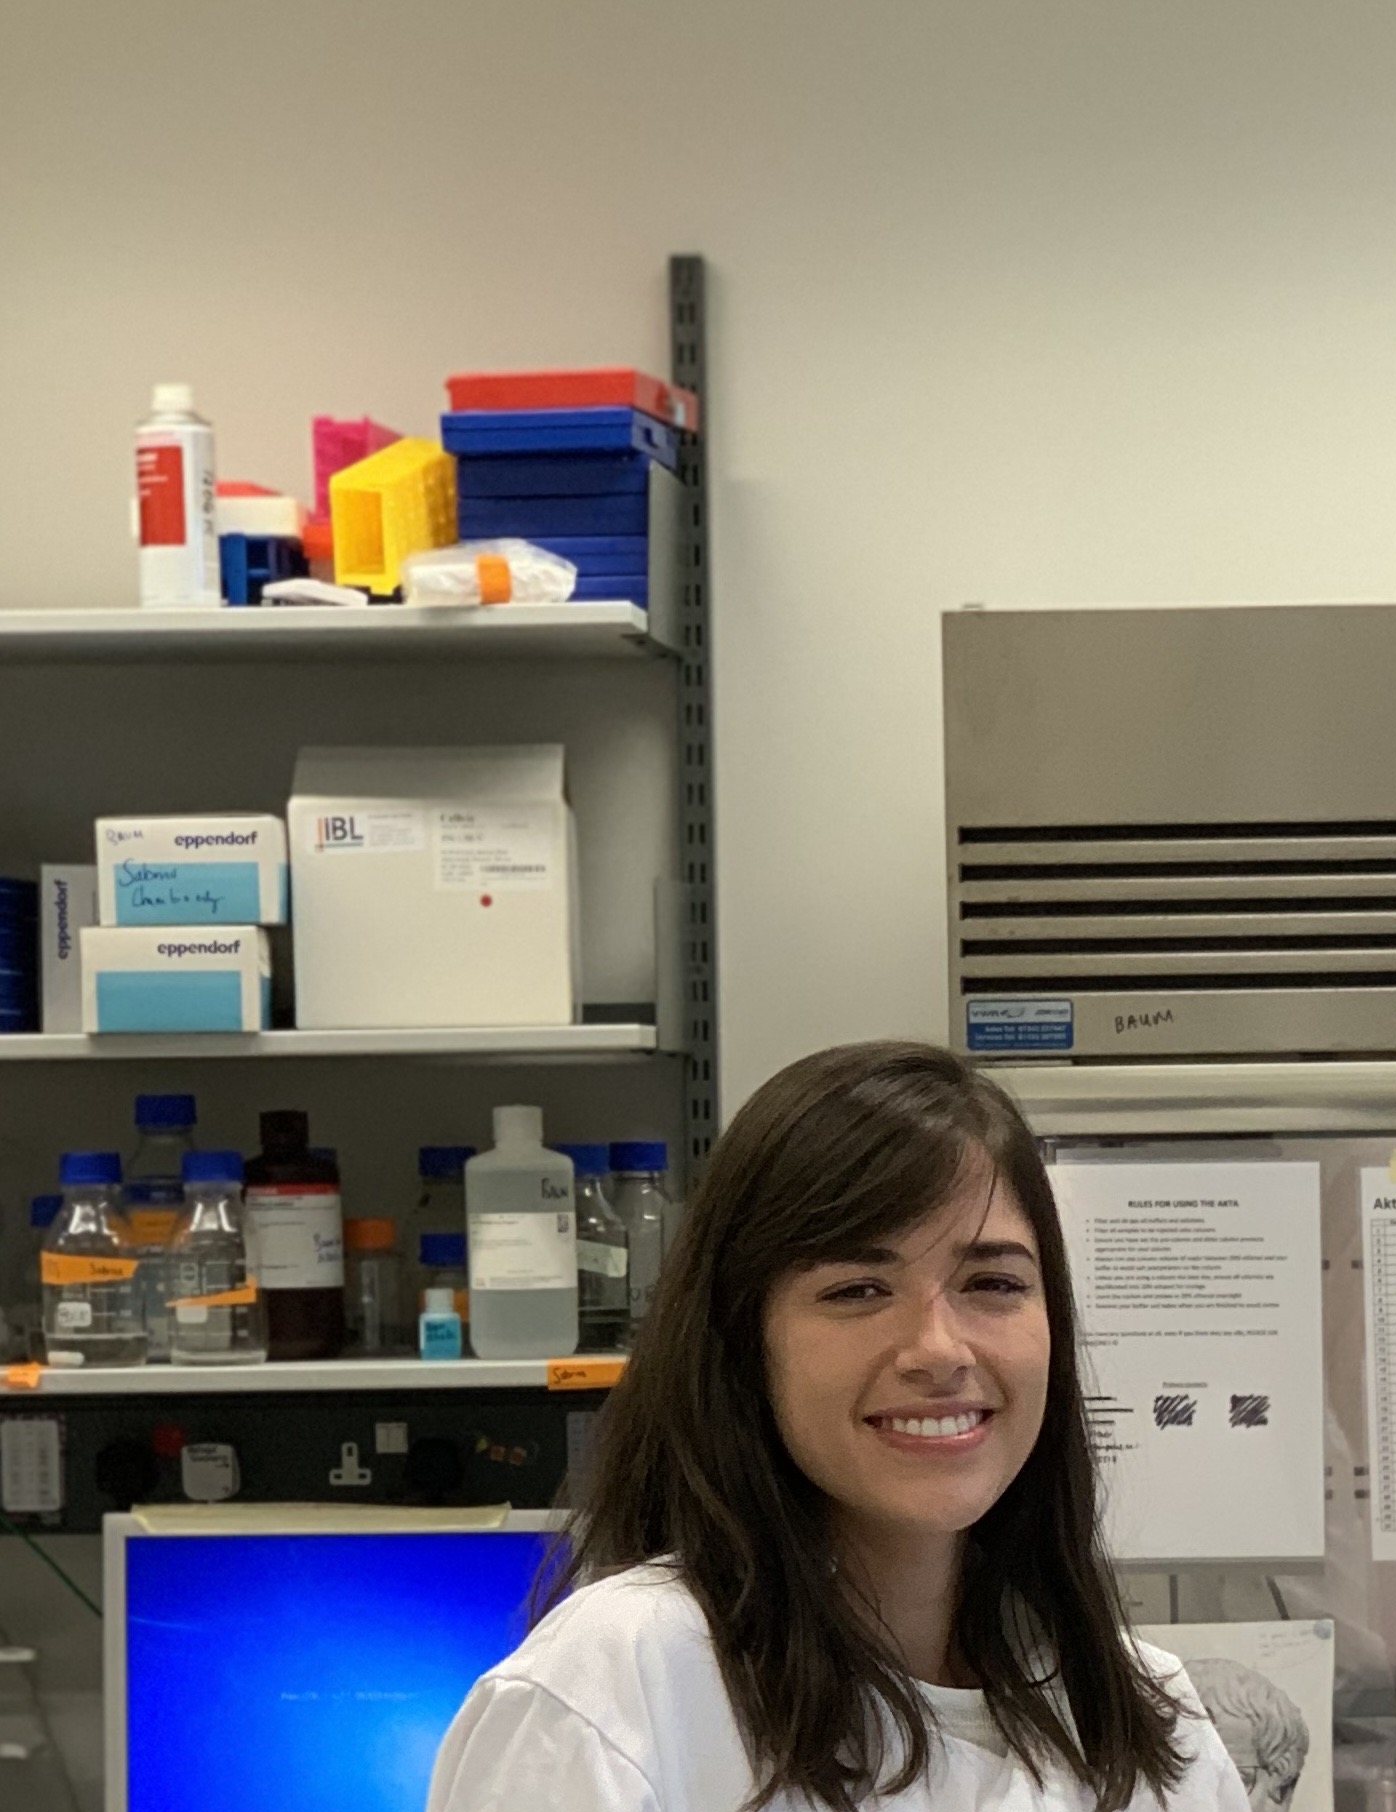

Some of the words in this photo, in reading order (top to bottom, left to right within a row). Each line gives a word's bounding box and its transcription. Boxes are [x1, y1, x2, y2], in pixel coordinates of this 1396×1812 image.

[174, 831, 257, 849] eppendorf
[52, 878, 71, 961] eppendorf
[157, 940, 240, 957] eppendorf
[1114, 1009, 1174, 1034] BAUM
[1128, 1200, 1152, 1208] RULES
[1155, 1200, 1170, 1208] FOR
[1173, 1200, 1198, 1208] USING
